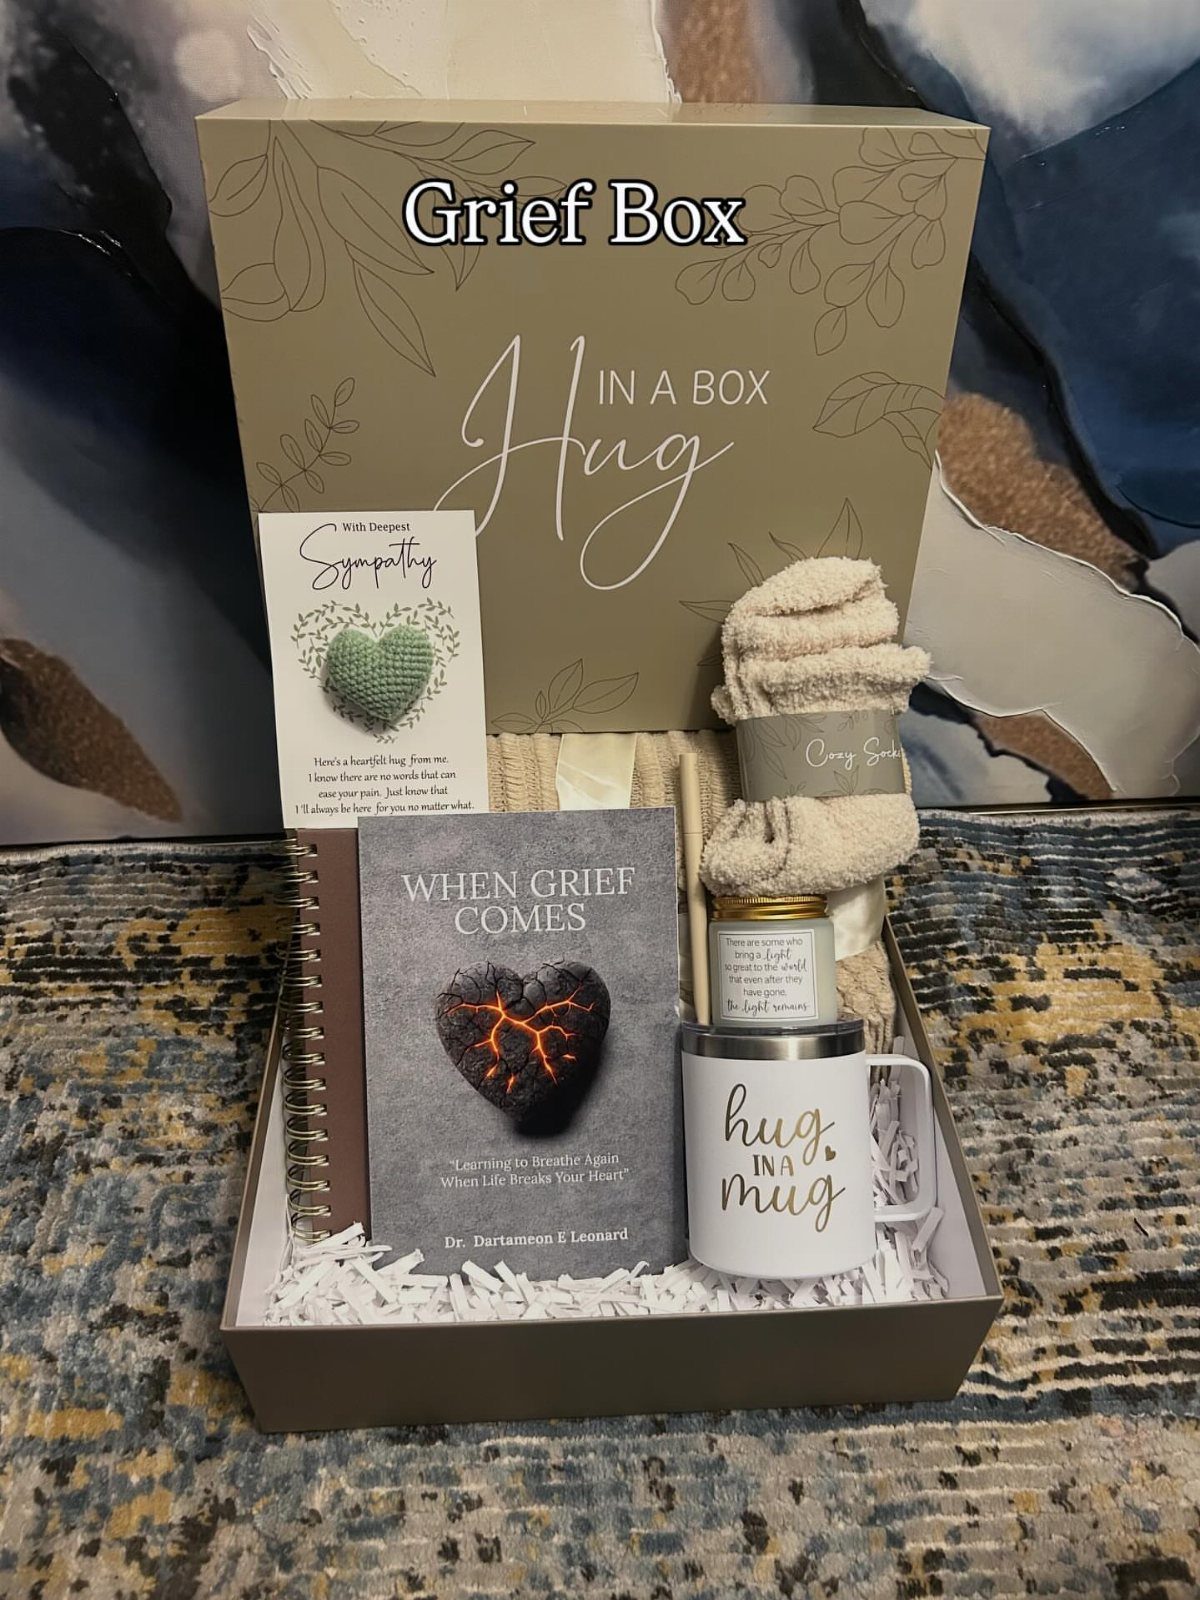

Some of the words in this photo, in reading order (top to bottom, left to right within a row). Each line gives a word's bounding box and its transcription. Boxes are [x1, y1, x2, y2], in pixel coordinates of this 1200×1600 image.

[598, 370, 635, 405] IN
[650, 370, 677, 405] A
[692, 370, 770, 405] BOX
[433, 334, 734, 590] Hug
[342, 522, 366, 532] With
[369, 522, 410, 533] Deepest
[299, 523, 437, 590] Sympathy
[314, 756, 341, 767] Here's
[350, 755, 386, 768] heartfelt
[389, 754, 406, 767] hug
[410, 754, 432, 767] from
[434, 755, 449, 764] me.
[805, 738, 857, 770] Cozy
[314, 773, 338, 782] know
[340, 772, 362, 782] there
[380, 773, 391, 781] no
[393, 770, 419, 780] words
[421, 770, 439, 780] that
[440, 771, 456, 779] can
[338, 791, 358, 800] your
[360, 789, 381, 800] pain.
[385, 787, 403, 799] Just
[405, 785, 428, 796] know
[430, 785, 448, 795] that
[311, 804, 339, 816] always
[340, 803, 350, 813] be
[353, 803, 371, 813] here
[376, 802, 389, 815] for
[390, 806, 406, 815] you
[421, 801, 449, 811] matter
[451, 801, 475, 810] what.
[400, 871, 518, 901] WHEN
[530, 867, 636, 898] GRIEF
[454, 902, 587, 935] COMES
[726, 937, 745, 947] There
[747, 939, 759, 947] are
[761, 938, 784, 946] some
[786, 936, 803, 946] who
[735, 951, 754, 961] bring
[764, 948, 791, 963] light
[733, 963, 752, 973] great
[754, 963, 762, 971] to
[764, 963, 778, 971] the
[781, 958, 807, 972] world
[729, 975, 742, 983] that
[744, 976, 762, 984] even
[765, 974, 783, 984] after
[785, 974, 803, 985] they
[743, 988, 761, 996] have
[727, 998, 738, 1011] the
[742, 1000, 768, 1016] light
[773, 1002, 807, 1012] remains
[725, 1083, 835, 1166] hug
[515, 1158, 528, 1168] to
[532, 1154, 580, 1167] Breathe
[584, 1152, 619, 1168] Again
[753, 1154, 775, 1176] IN
[780, 1154, 794, 1176] A
[440, 1176, 479, 1188] When
[482, 1174, 506, 1186] Life
[510, 1172, 551, 1186] Breaks
[555, 1171, 585, 1183] Your
[722, 1174, 846, 1232] mug
[445, 1236, 466, 1248] Dr.
[474, 1233, 553, 1247] Dartameon
[557, 1231, 567, 1243] E
[571, 1228, 628, 1243] Leonard
